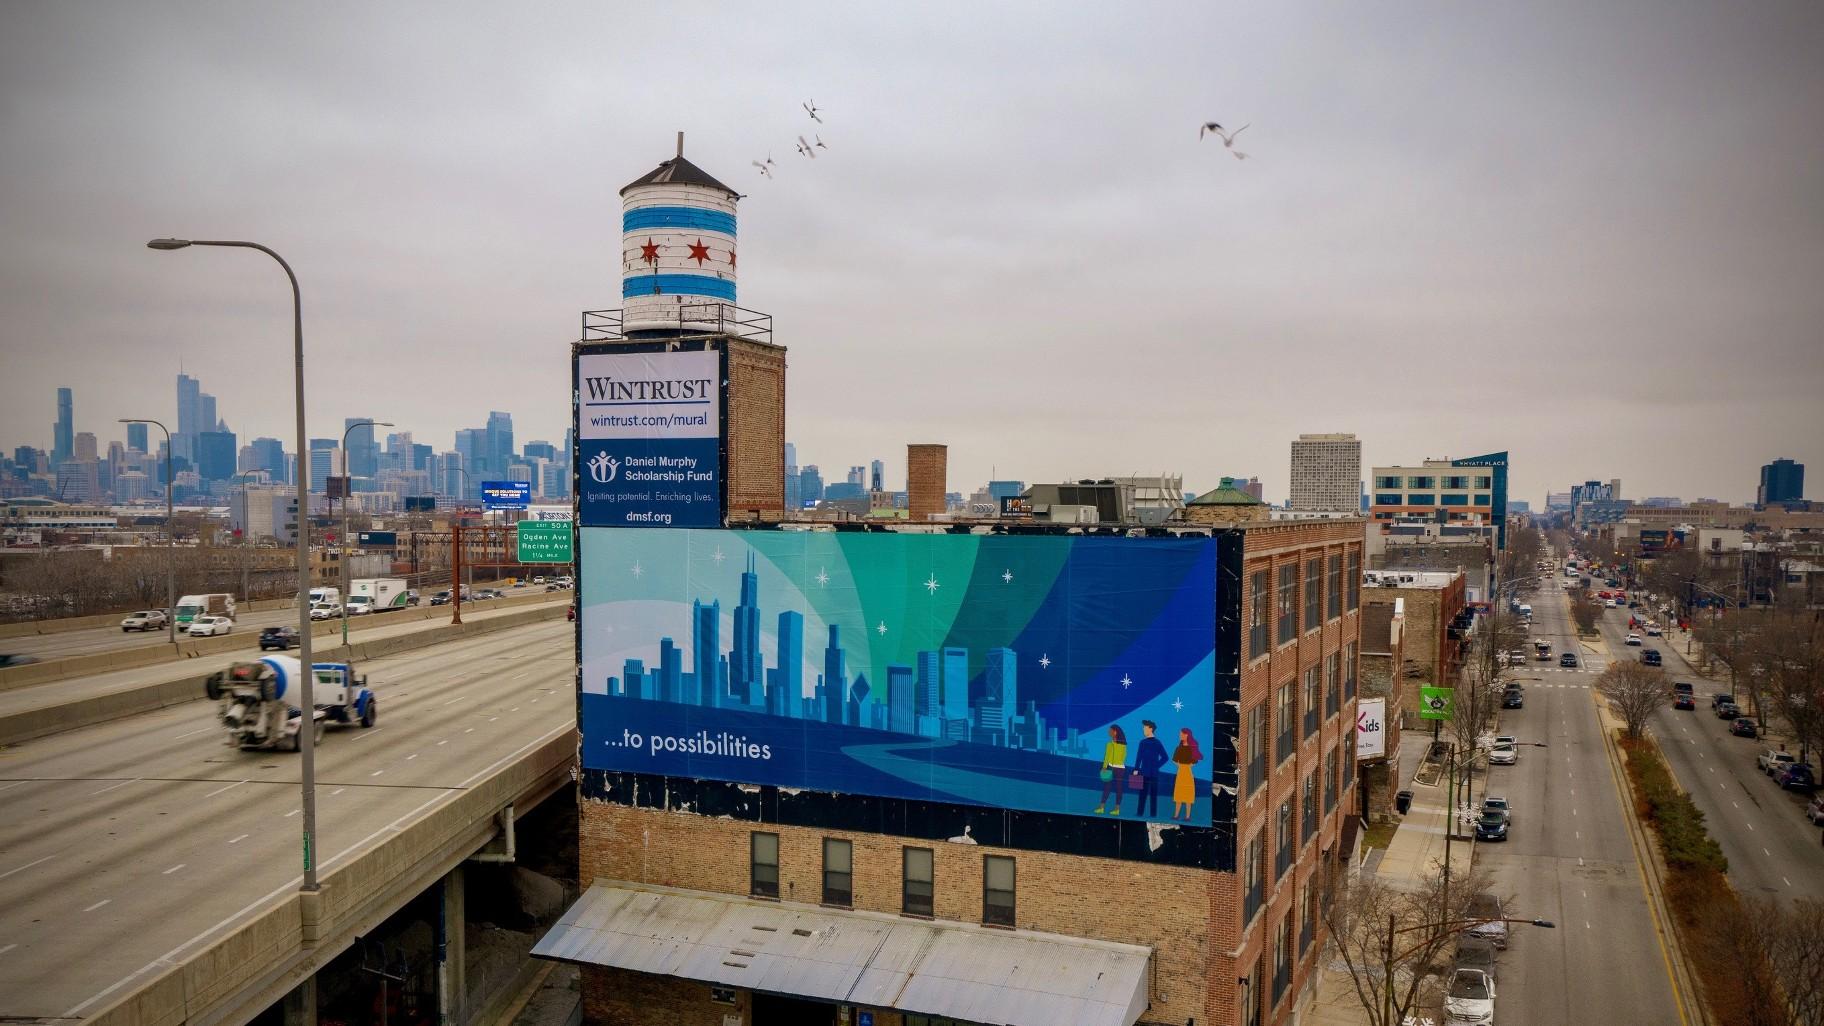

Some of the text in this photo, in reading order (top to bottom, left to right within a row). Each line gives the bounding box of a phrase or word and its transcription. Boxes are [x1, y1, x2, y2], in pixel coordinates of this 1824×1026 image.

[585, 376, 711, 401] WINTRUST
[591, 411, 707, 429] wintrust.com/mural
[625, 456, 697, 470] Daniel Murphy
[625, 470, 713, 483] Scholarship Fund
[587, 490, 714, 504] Igniting potential. Enriching lives.
[626, 511, 672, 525] dmsf.org
[523, 533, 548, 542] Ogden
[651, 730, 772, 760] possibilities
